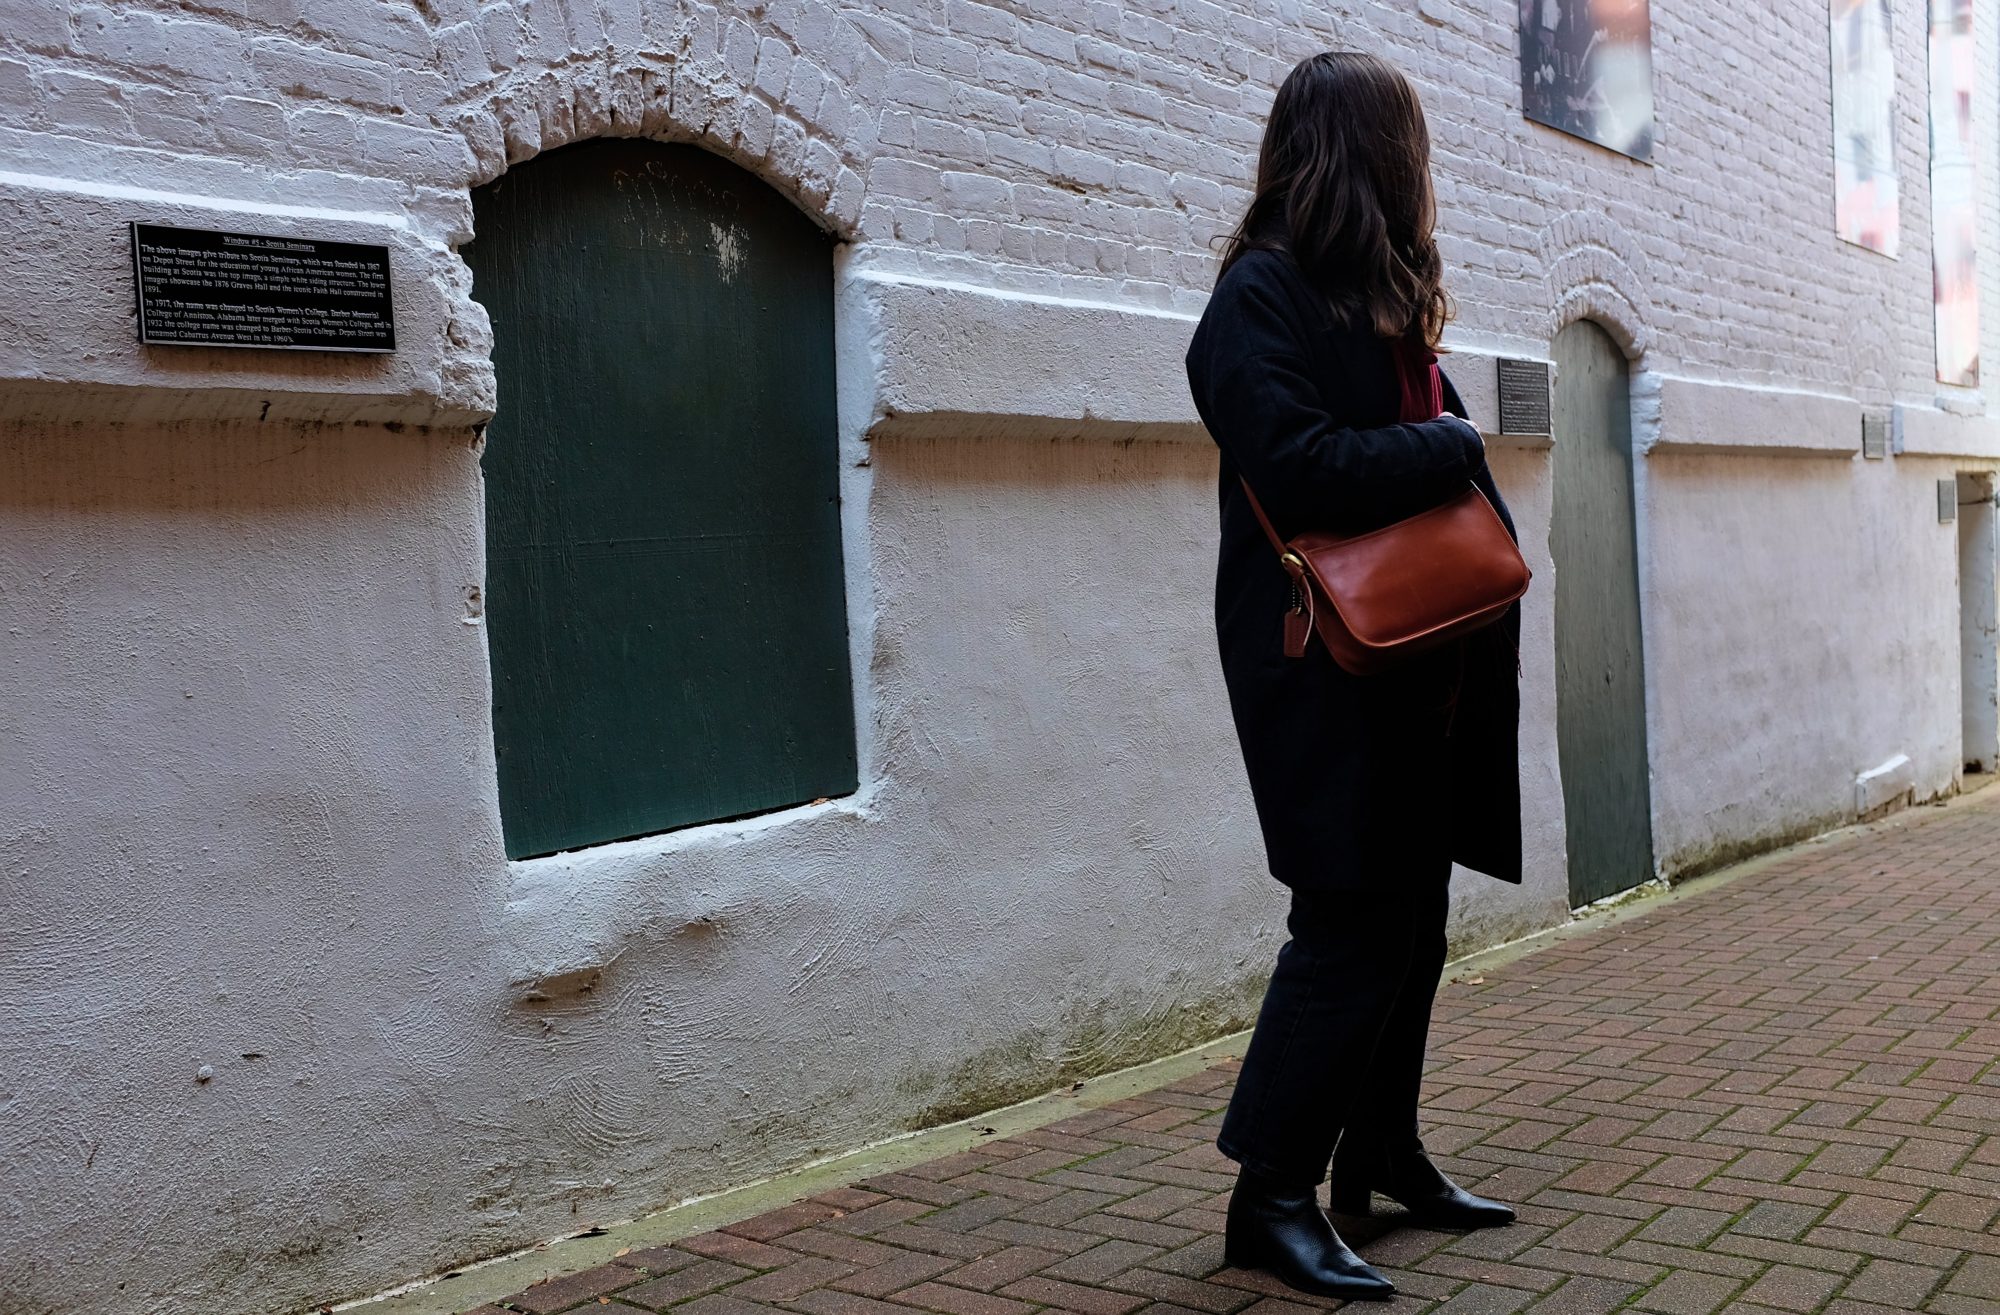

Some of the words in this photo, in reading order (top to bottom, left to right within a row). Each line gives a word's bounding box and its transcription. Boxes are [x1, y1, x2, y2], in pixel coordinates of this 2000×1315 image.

[224, 236, 249, 245] Window
[266, 240, 285, 248] Scotia
[286, 241, 315, 251] Seminary
[140, 244, 155, 252] The
[156, 245, 176, 254] above
[177, 247, 201, 258] images
[202, 250, 217, 259] give
[217, 251, 240, 260] tribute
[249, 253, 269, 262] Scotia
[270, 255, 301, 265] Seminary,
[302, 257, 320, 266] which
[143, 265, 171, 275] building
[181, 268, 202, 276] Scotia
[270, 275, 289, 283] simple
[309, 277, 327, 286] siding
[329, 279, 355, 287] structure.
[370, 281, 385, 289] lower
[153, 255, 173, 265] Depot
[175, 257, 194, 266] Street
[197, 259, 206, 267] for
[219, 261, 250, 270] education
[251, 263, 259, 271] of
[260, 265, 279, 273] young
[281, 266, 304, 274] African
[305, 268, 334, 276] American
[359, 271, 370, 279] The
[144, 276, 168, 285] images
[170, 277, 200, 286] showcase
[215, 280, 229, 288] 1876
[230, 281, 252, 289] Graves
[313, 286, 328, 294] Faith
[343, 289, 376, 297] constructed
[145, 298, 153, 306] In
[155, 299, 172, 307] 1917,
[172, 300, 184, 308] the
[218, 303, 246, 313] changed
[254, 305, 275, 313] Scotia
[275, 306, 304, 314] Women's
[330, 309, 351, 317] Barber
[351, 310, 379, 319] Memorial
[147, 309, 172, 319] College
[174, 310, 181, 318] of
[217, 313, 245, 321] Alabama
[247, 314, 260, 322] later
[262, 316, 285, 325] merged
[302, 317, 320, 325] Scotia
[322, 317, 348, 326] Women's
[349, 320, 372, 329] College,
[148, 329, 177, 337] renamed
[179, 330, 209, 339] Cabarrus
[176, 320, 201, 330] college
[235, 324, 262, 333] changed
[270, 325, 312, 334] Barber-Scotia
[338, 328, 356, 336] Depot
[357, 328, 374, 337] Street
